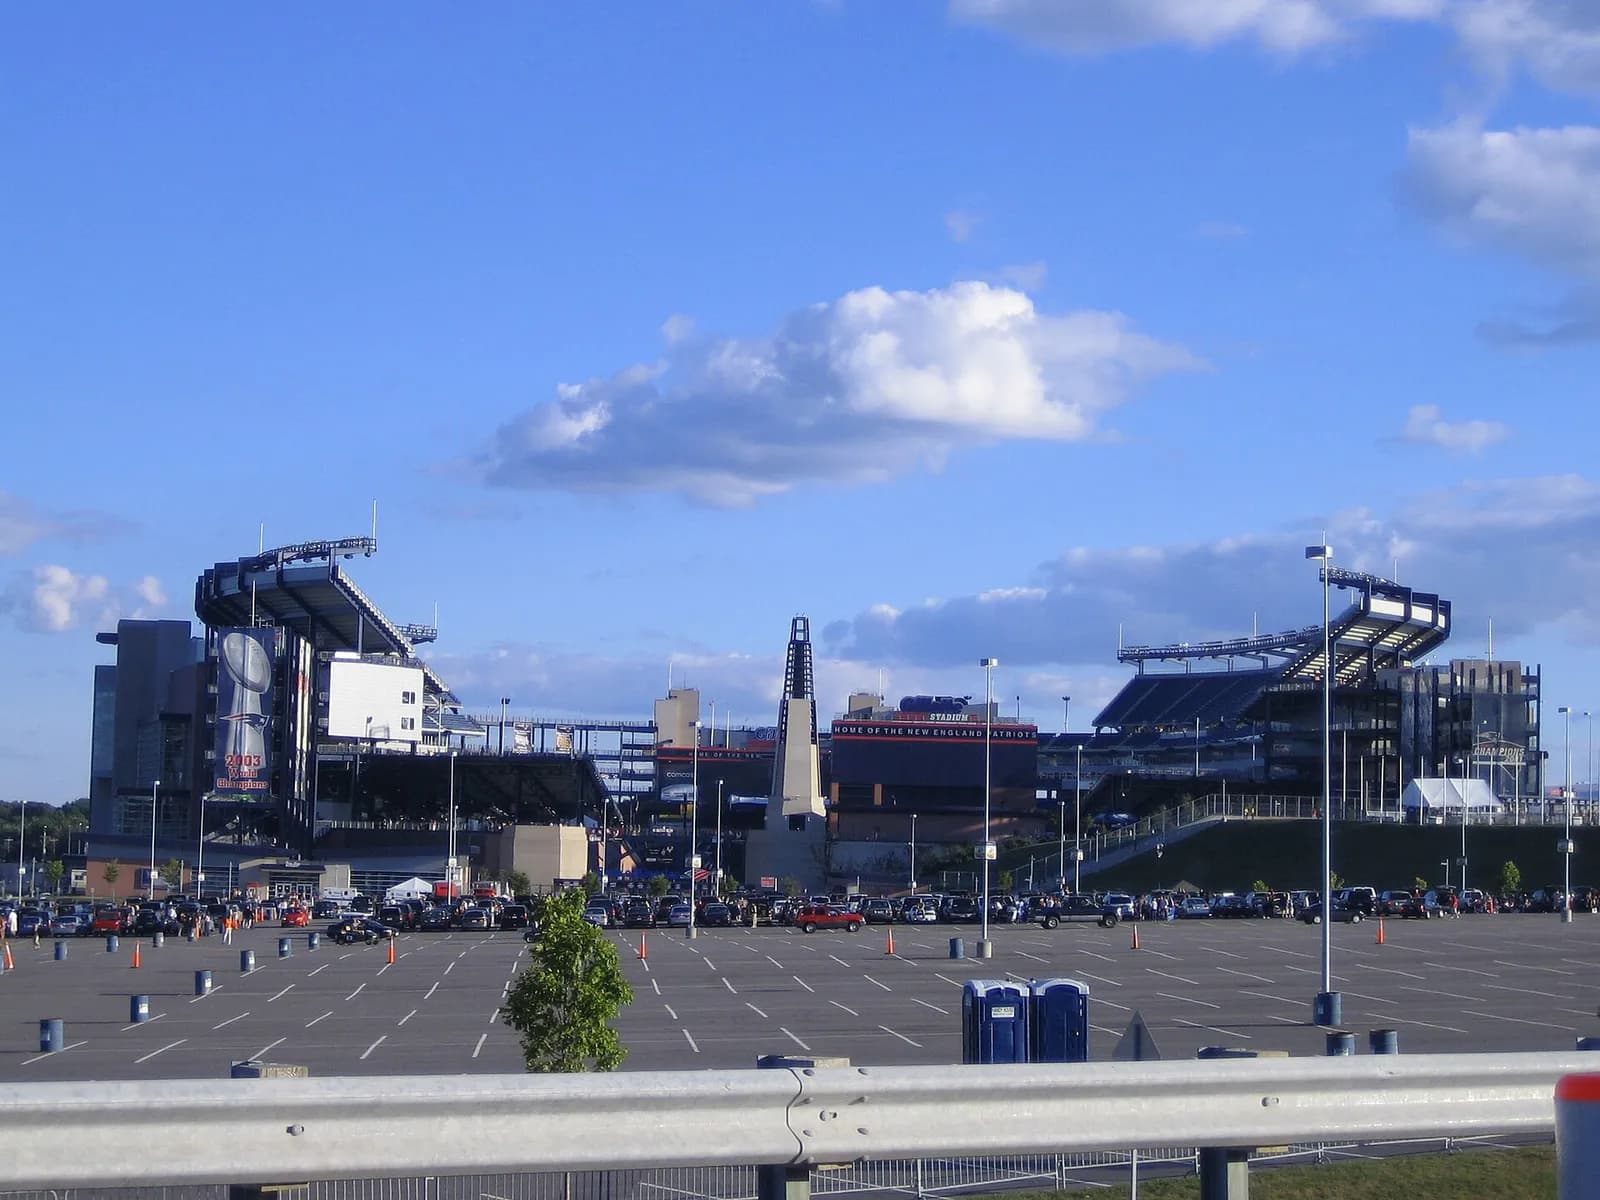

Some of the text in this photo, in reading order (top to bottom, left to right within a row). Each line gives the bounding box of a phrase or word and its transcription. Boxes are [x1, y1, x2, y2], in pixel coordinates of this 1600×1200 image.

[930, 713, 968, 721] STADIUM
[834, 726, 864, 734] HOME
[884, 727, 904, 735] THE
[907, 728, 929, 736] NEW
[933, 729, 983, 737] ENGLAND
[1474, 747, 1525, 756] CHAMPIONS
[225, 754, 262, 767] 2003
[229, 768, 257, 779] World
[217, 777, 269, 790] Champions
